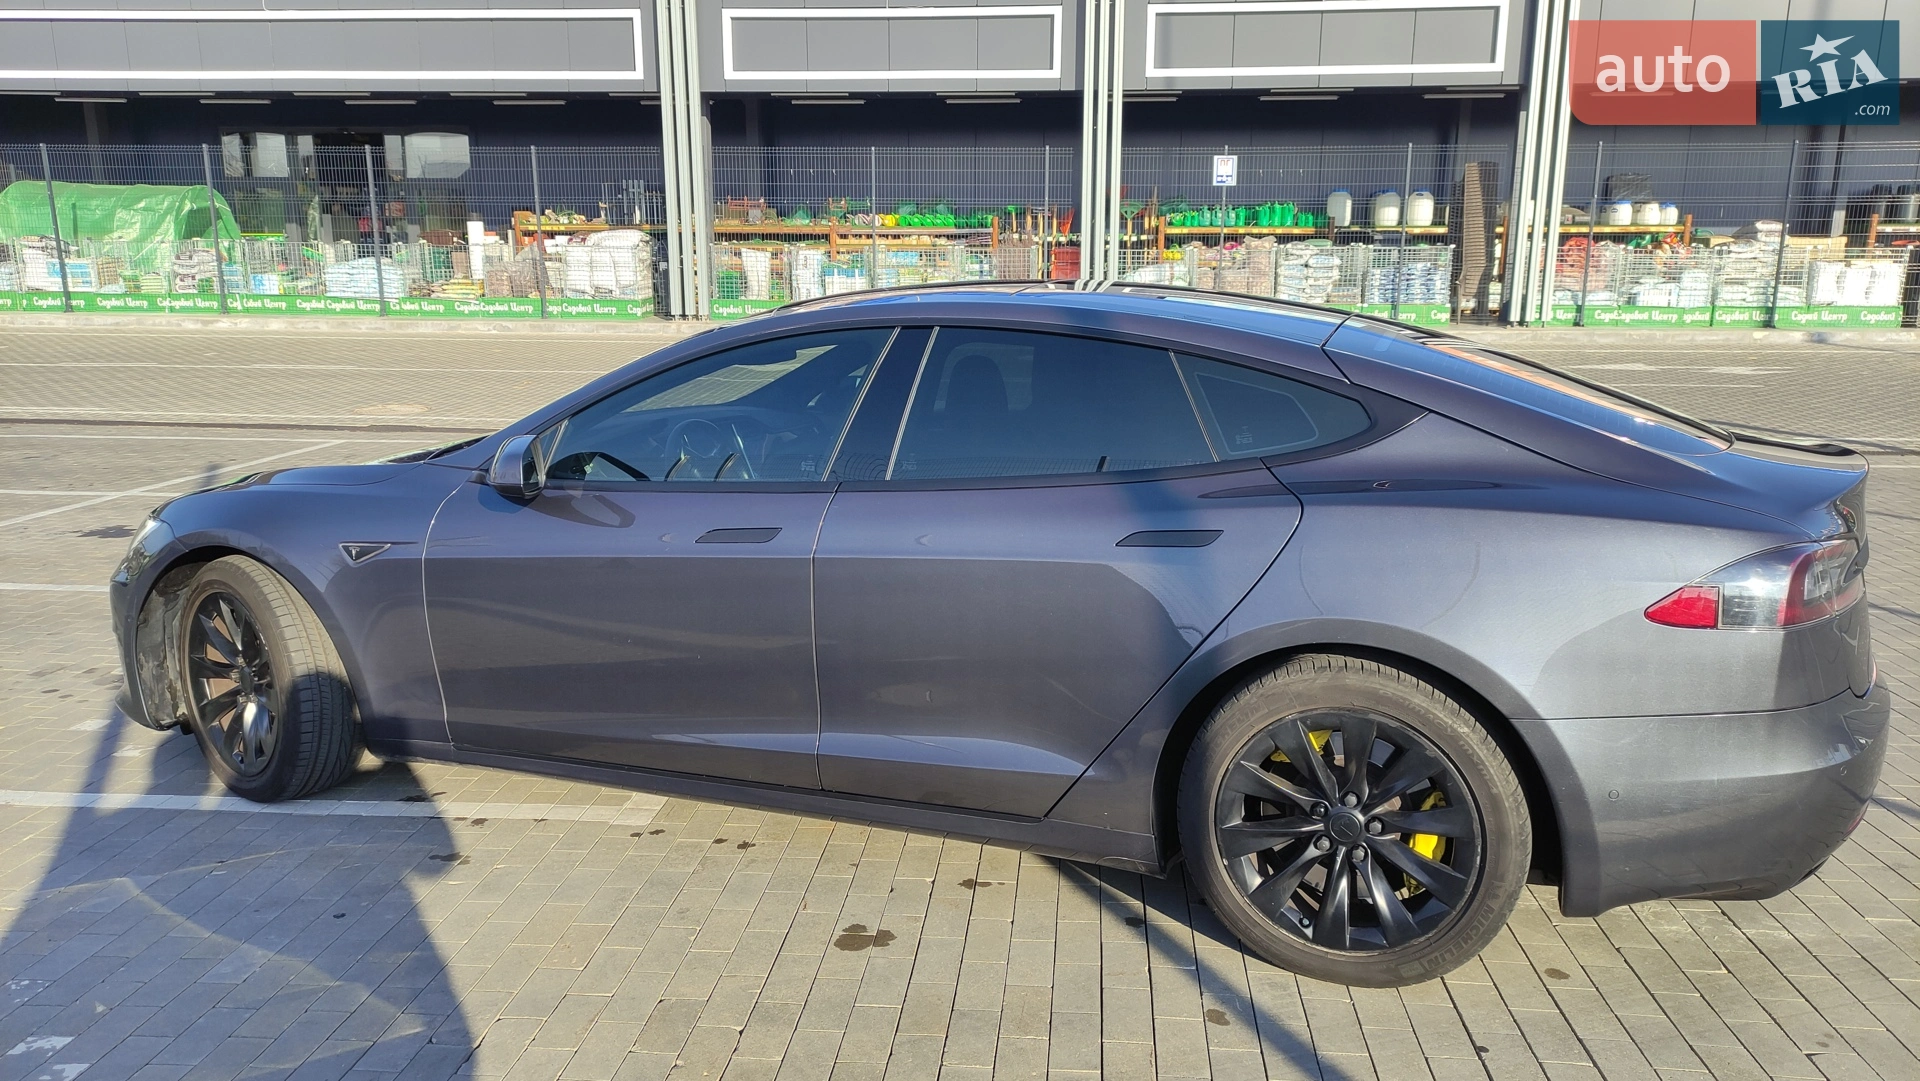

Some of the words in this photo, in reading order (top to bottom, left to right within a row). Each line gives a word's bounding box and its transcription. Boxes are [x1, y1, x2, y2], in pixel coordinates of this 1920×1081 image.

[594, 304, 617, 315] Центр
[713, 304, 743, 316] Садовий
[1424, 903, 1496, 970] MICHELIN
